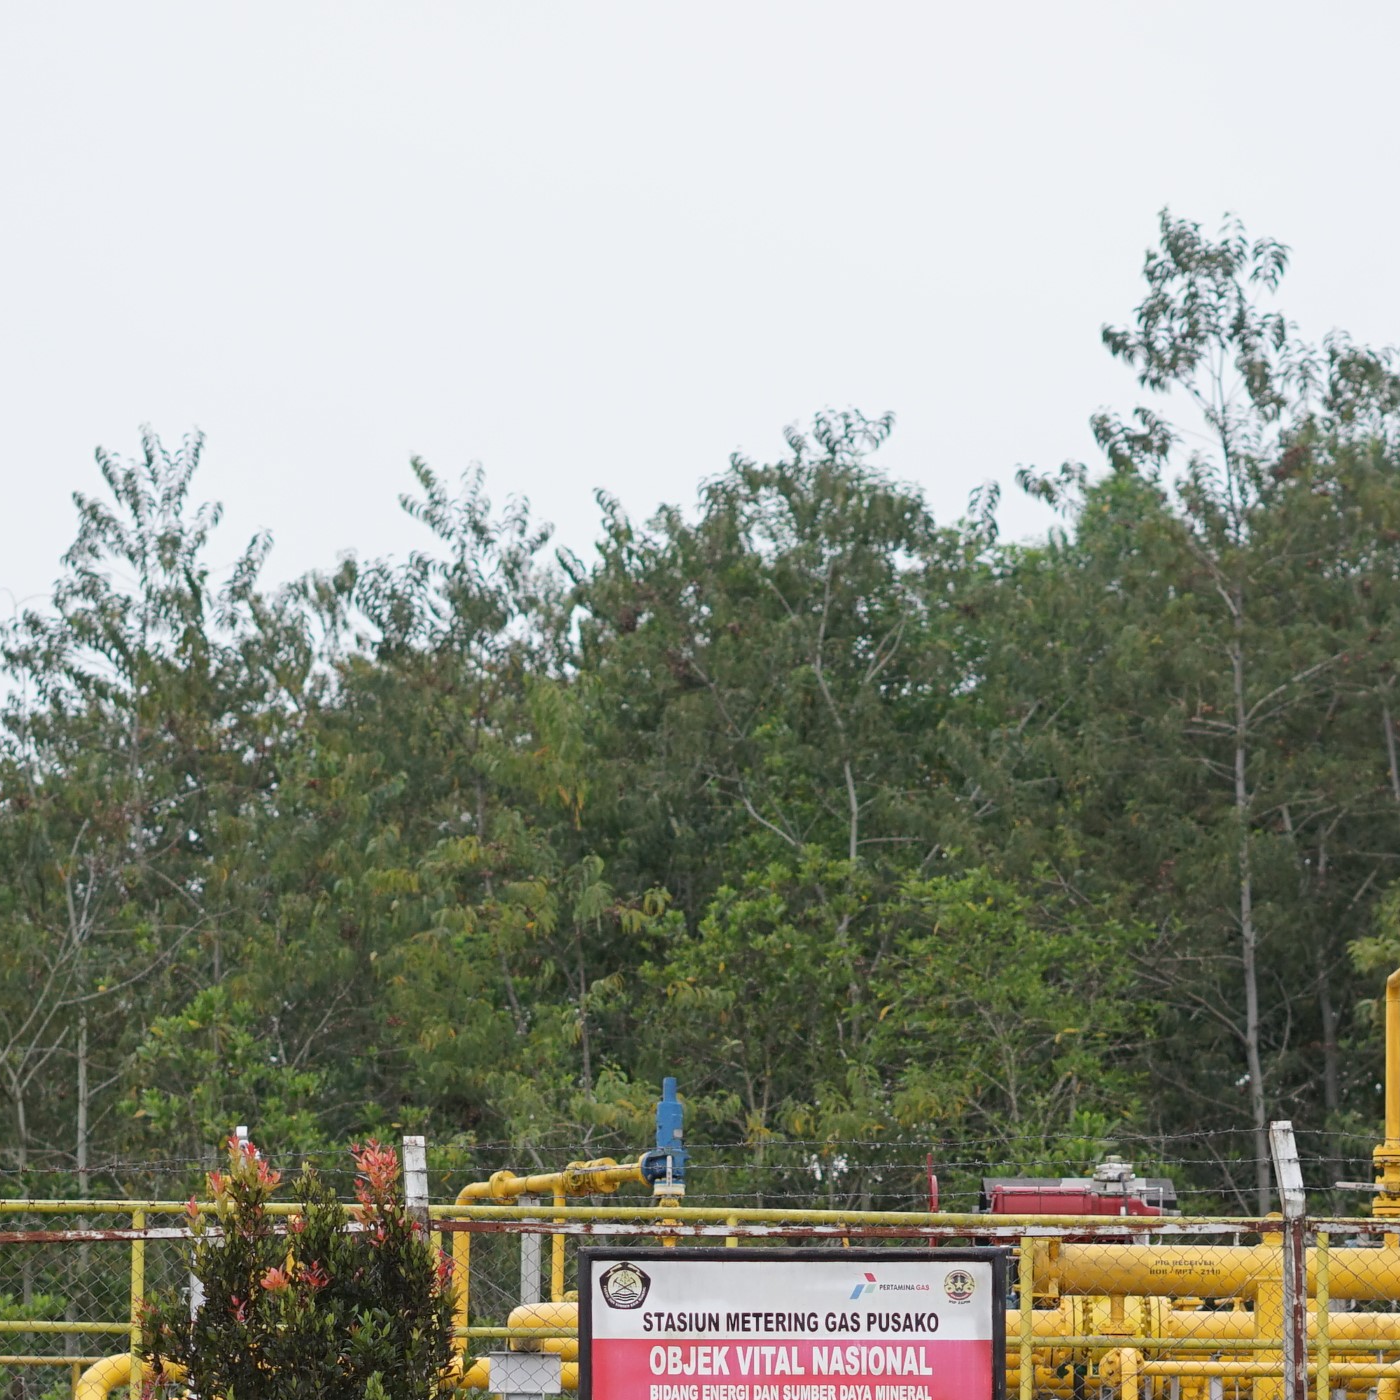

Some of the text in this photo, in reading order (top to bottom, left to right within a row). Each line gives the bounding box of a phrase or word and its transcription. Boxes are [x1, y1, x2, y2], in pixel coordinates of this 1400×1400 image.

[879, 1283, 930, 1291] PERTAMINA GAS
[642, 1311, 939, 1333] STASIUN METERING GAS PUSAKO
[649, 1343, 933, 1376] OBJEK VITAL NASIONAL
[649, 1384, 699, 1400] BIDANG
[702, 1384, 750, 1400] ENERGI
[753, 1384, 780, 1400] DAN
[839, 1384, 873, 1400] DAYA
